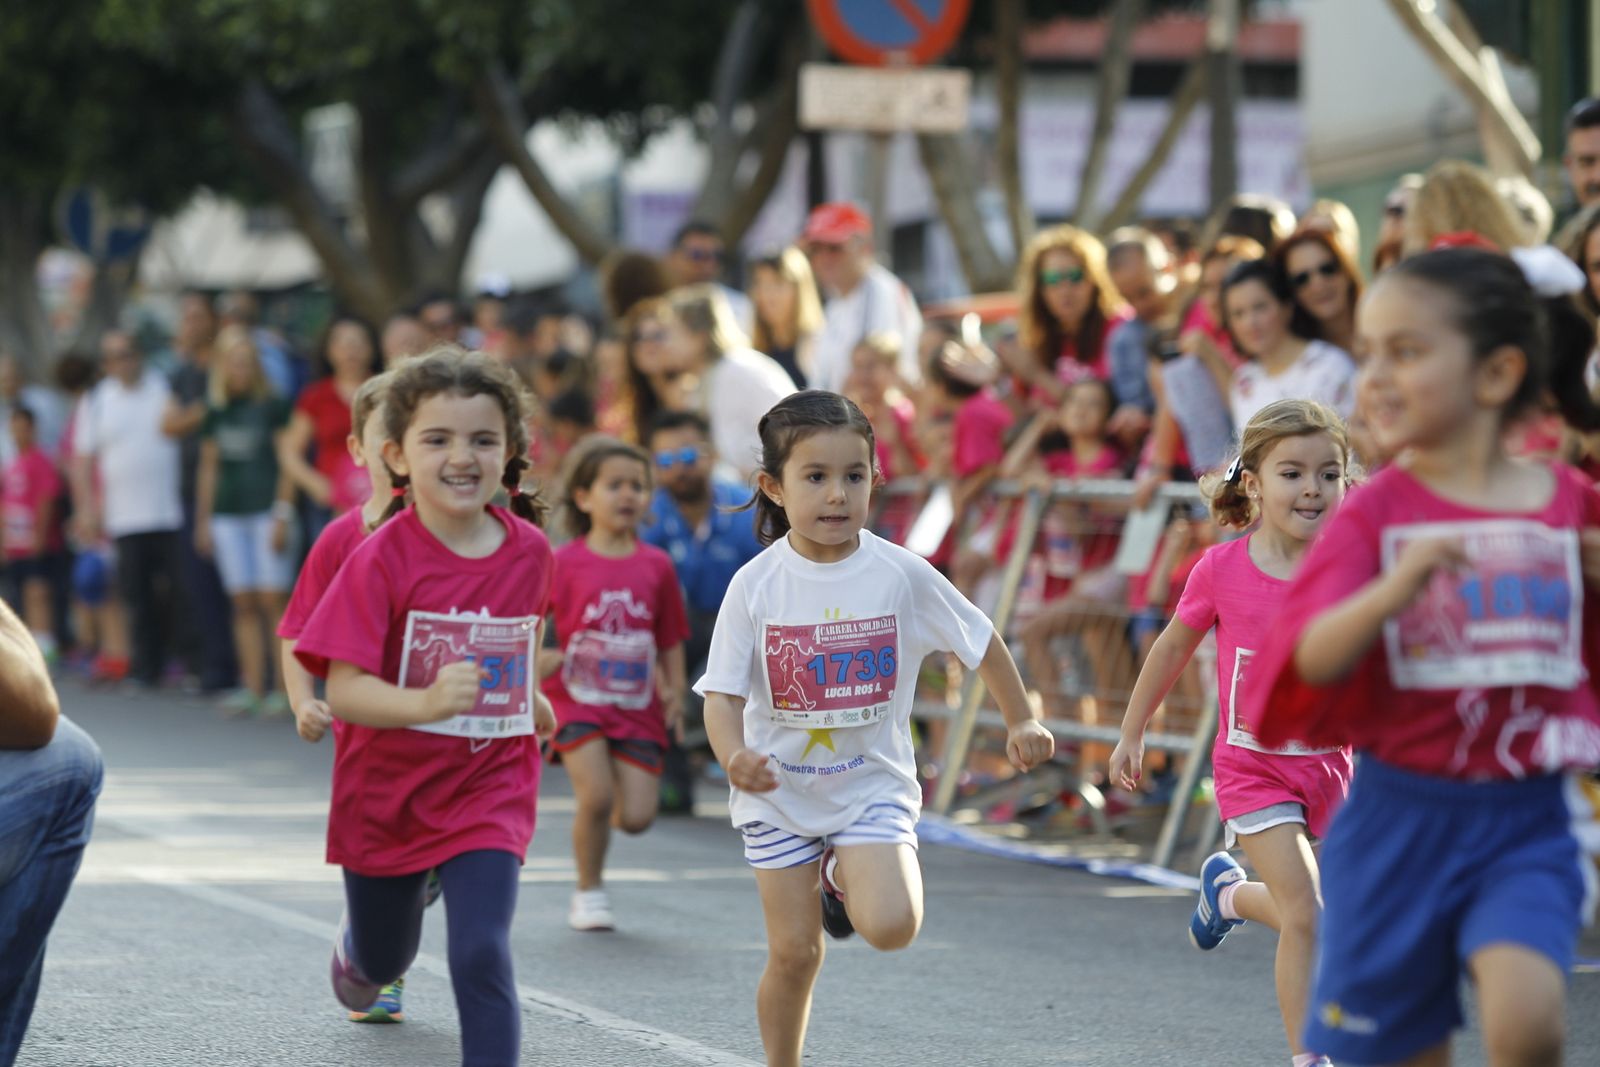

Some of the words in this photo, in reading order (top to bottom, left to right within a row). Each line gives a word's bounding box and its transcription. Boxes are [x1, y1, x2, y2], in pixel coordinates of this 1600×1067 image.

[820, 623, 858, 636] CARRERA
[858, 617, 895, 632] SOLIDARIA
[807, 646, 896, 686] 1736
[824, 685, 852, 699] LUCIA
[854, 684, 873, 697] ROS
[781, 762, 817, 775] nuestras
[818, 764, 847, 776] manos
